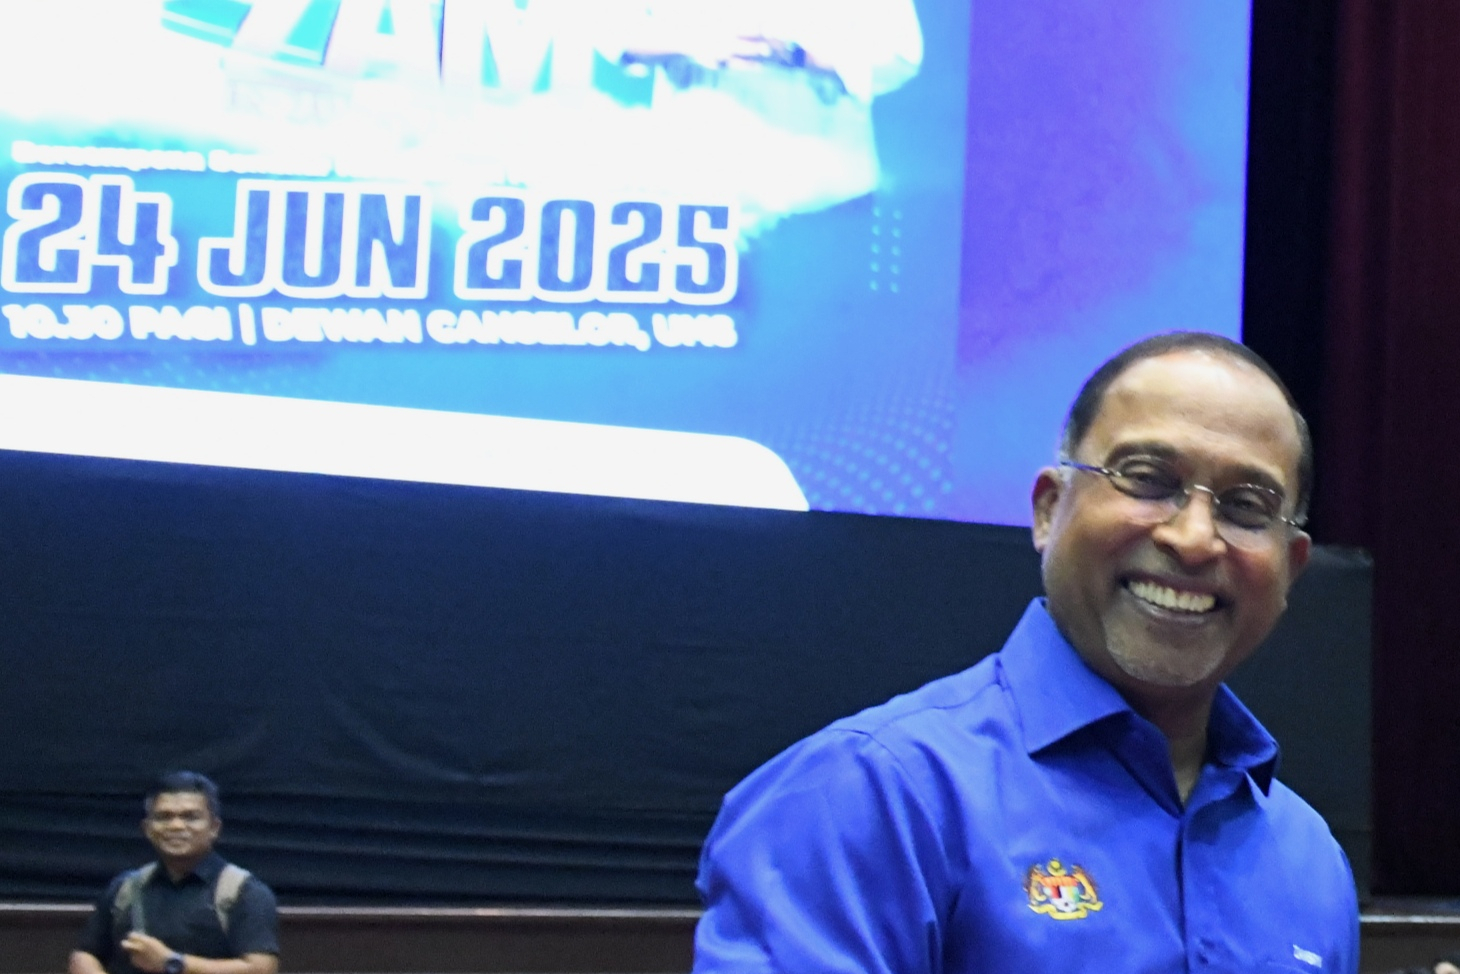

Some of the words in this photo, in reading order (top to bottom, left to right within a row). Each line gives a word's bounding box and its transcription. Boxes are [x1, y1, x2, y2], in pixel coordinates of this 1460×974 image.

[3, 173, 178, 294] 24
[196, 179, 432, 299] JUN
[454, 190, 739, 305] 2025
